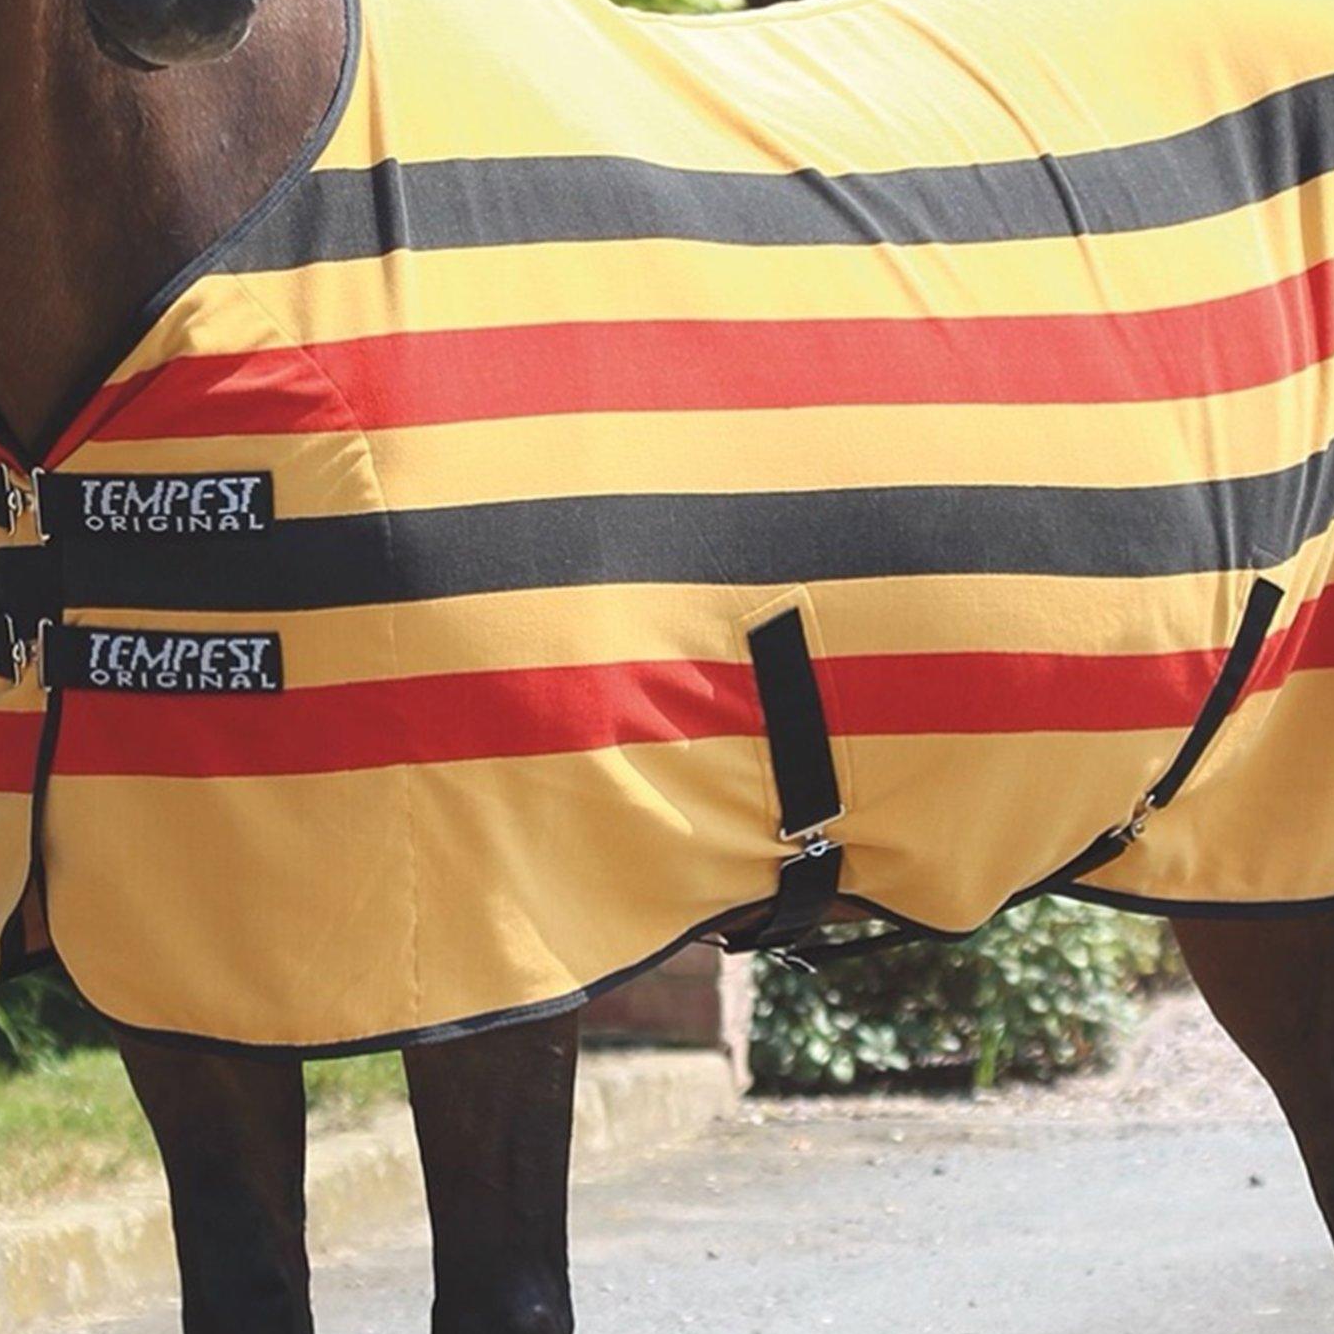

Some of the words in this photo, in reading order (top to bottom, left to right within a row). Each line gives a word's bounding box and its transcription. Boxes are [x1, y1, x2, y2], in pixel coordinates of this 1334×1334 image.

[81, 477, 261, 515] TEMPEST
[85, 514, 264, 533] ORIGINAL
[90, 633, 271, 673] TEMPEST
[90, 669, 277, 689] ORIGINAL
